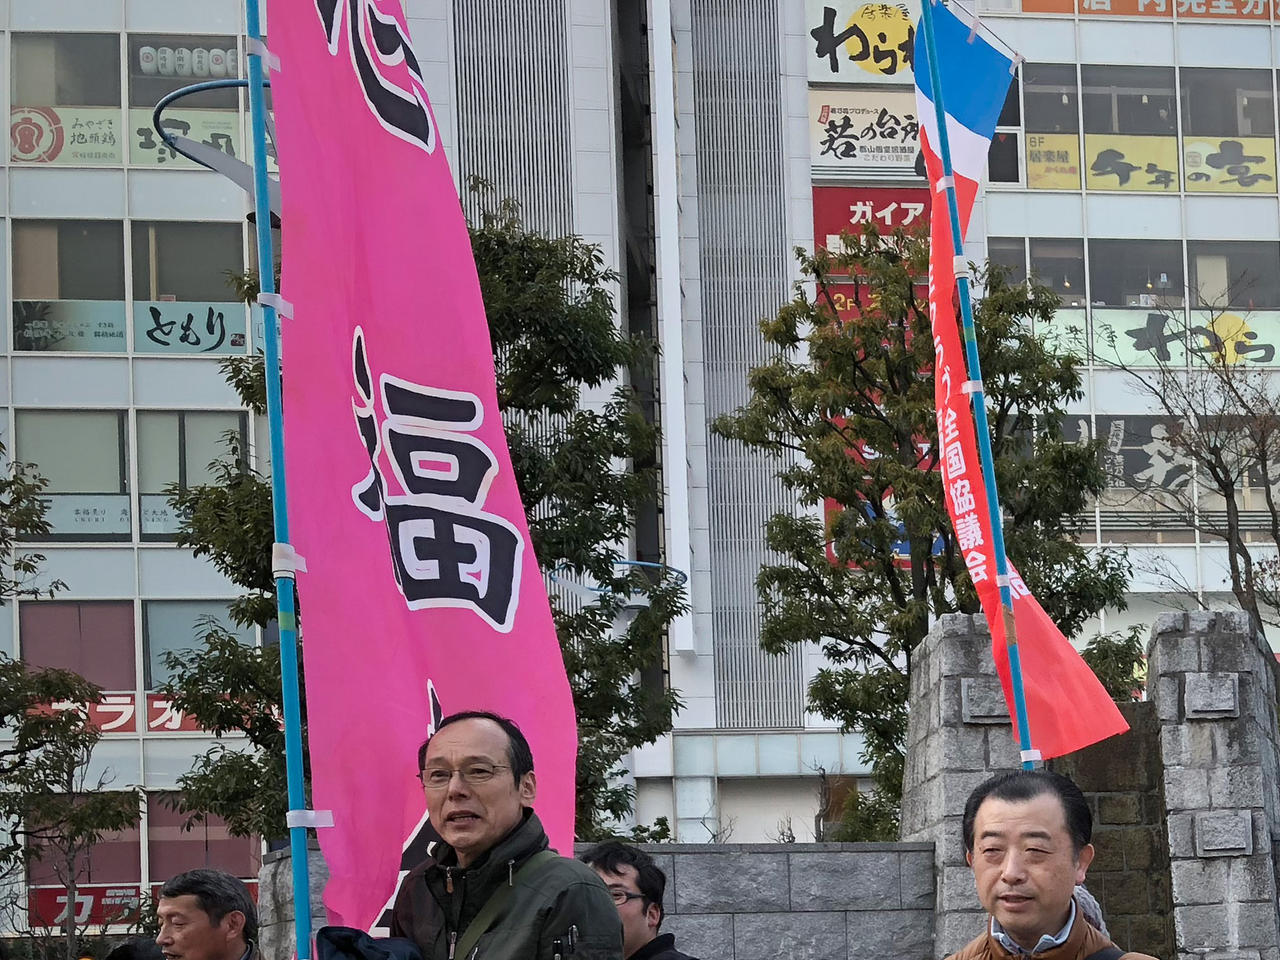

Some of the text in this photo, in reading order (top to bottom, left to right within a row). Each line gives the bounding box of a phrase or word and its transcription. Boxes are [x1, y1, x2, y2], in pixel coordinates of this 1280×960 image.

[849, 200, 925, 226] ガイア
[146, 306, 226, 353] ともり
